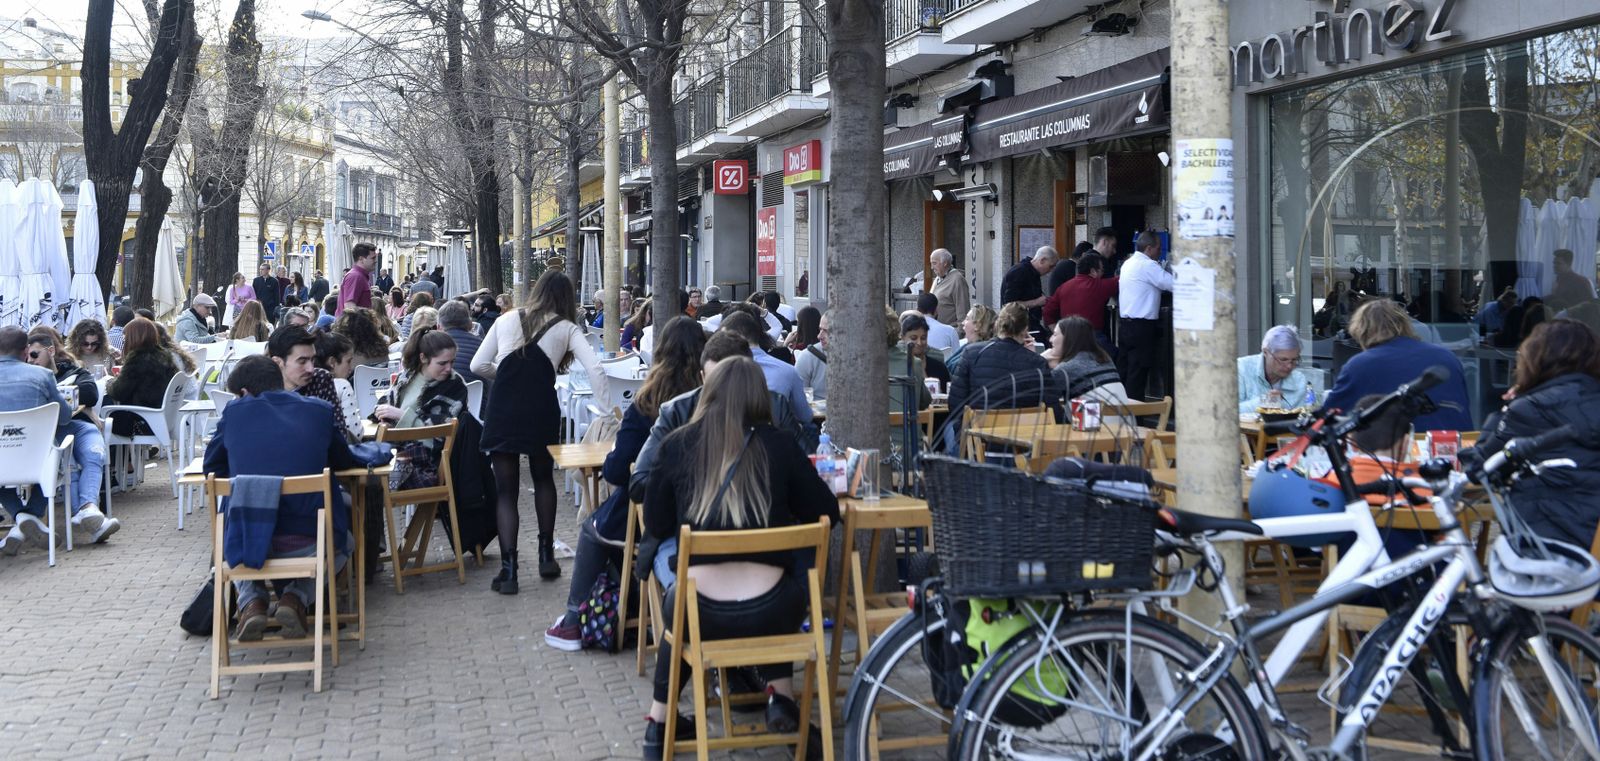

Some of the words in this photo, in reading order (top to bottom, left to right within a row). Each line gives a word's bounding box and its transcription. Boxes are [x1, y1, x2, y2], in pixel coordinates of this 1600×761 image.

[1000, 126, 1040, 148] RESTAURANTE
[1041, 122, 1053, 138] LAS
[1054, 113, 1091, 136] COLUMNAS
[889, 157, 910, 172] COLUMNAS
[1361, 606, 1440, 726] APACHE
